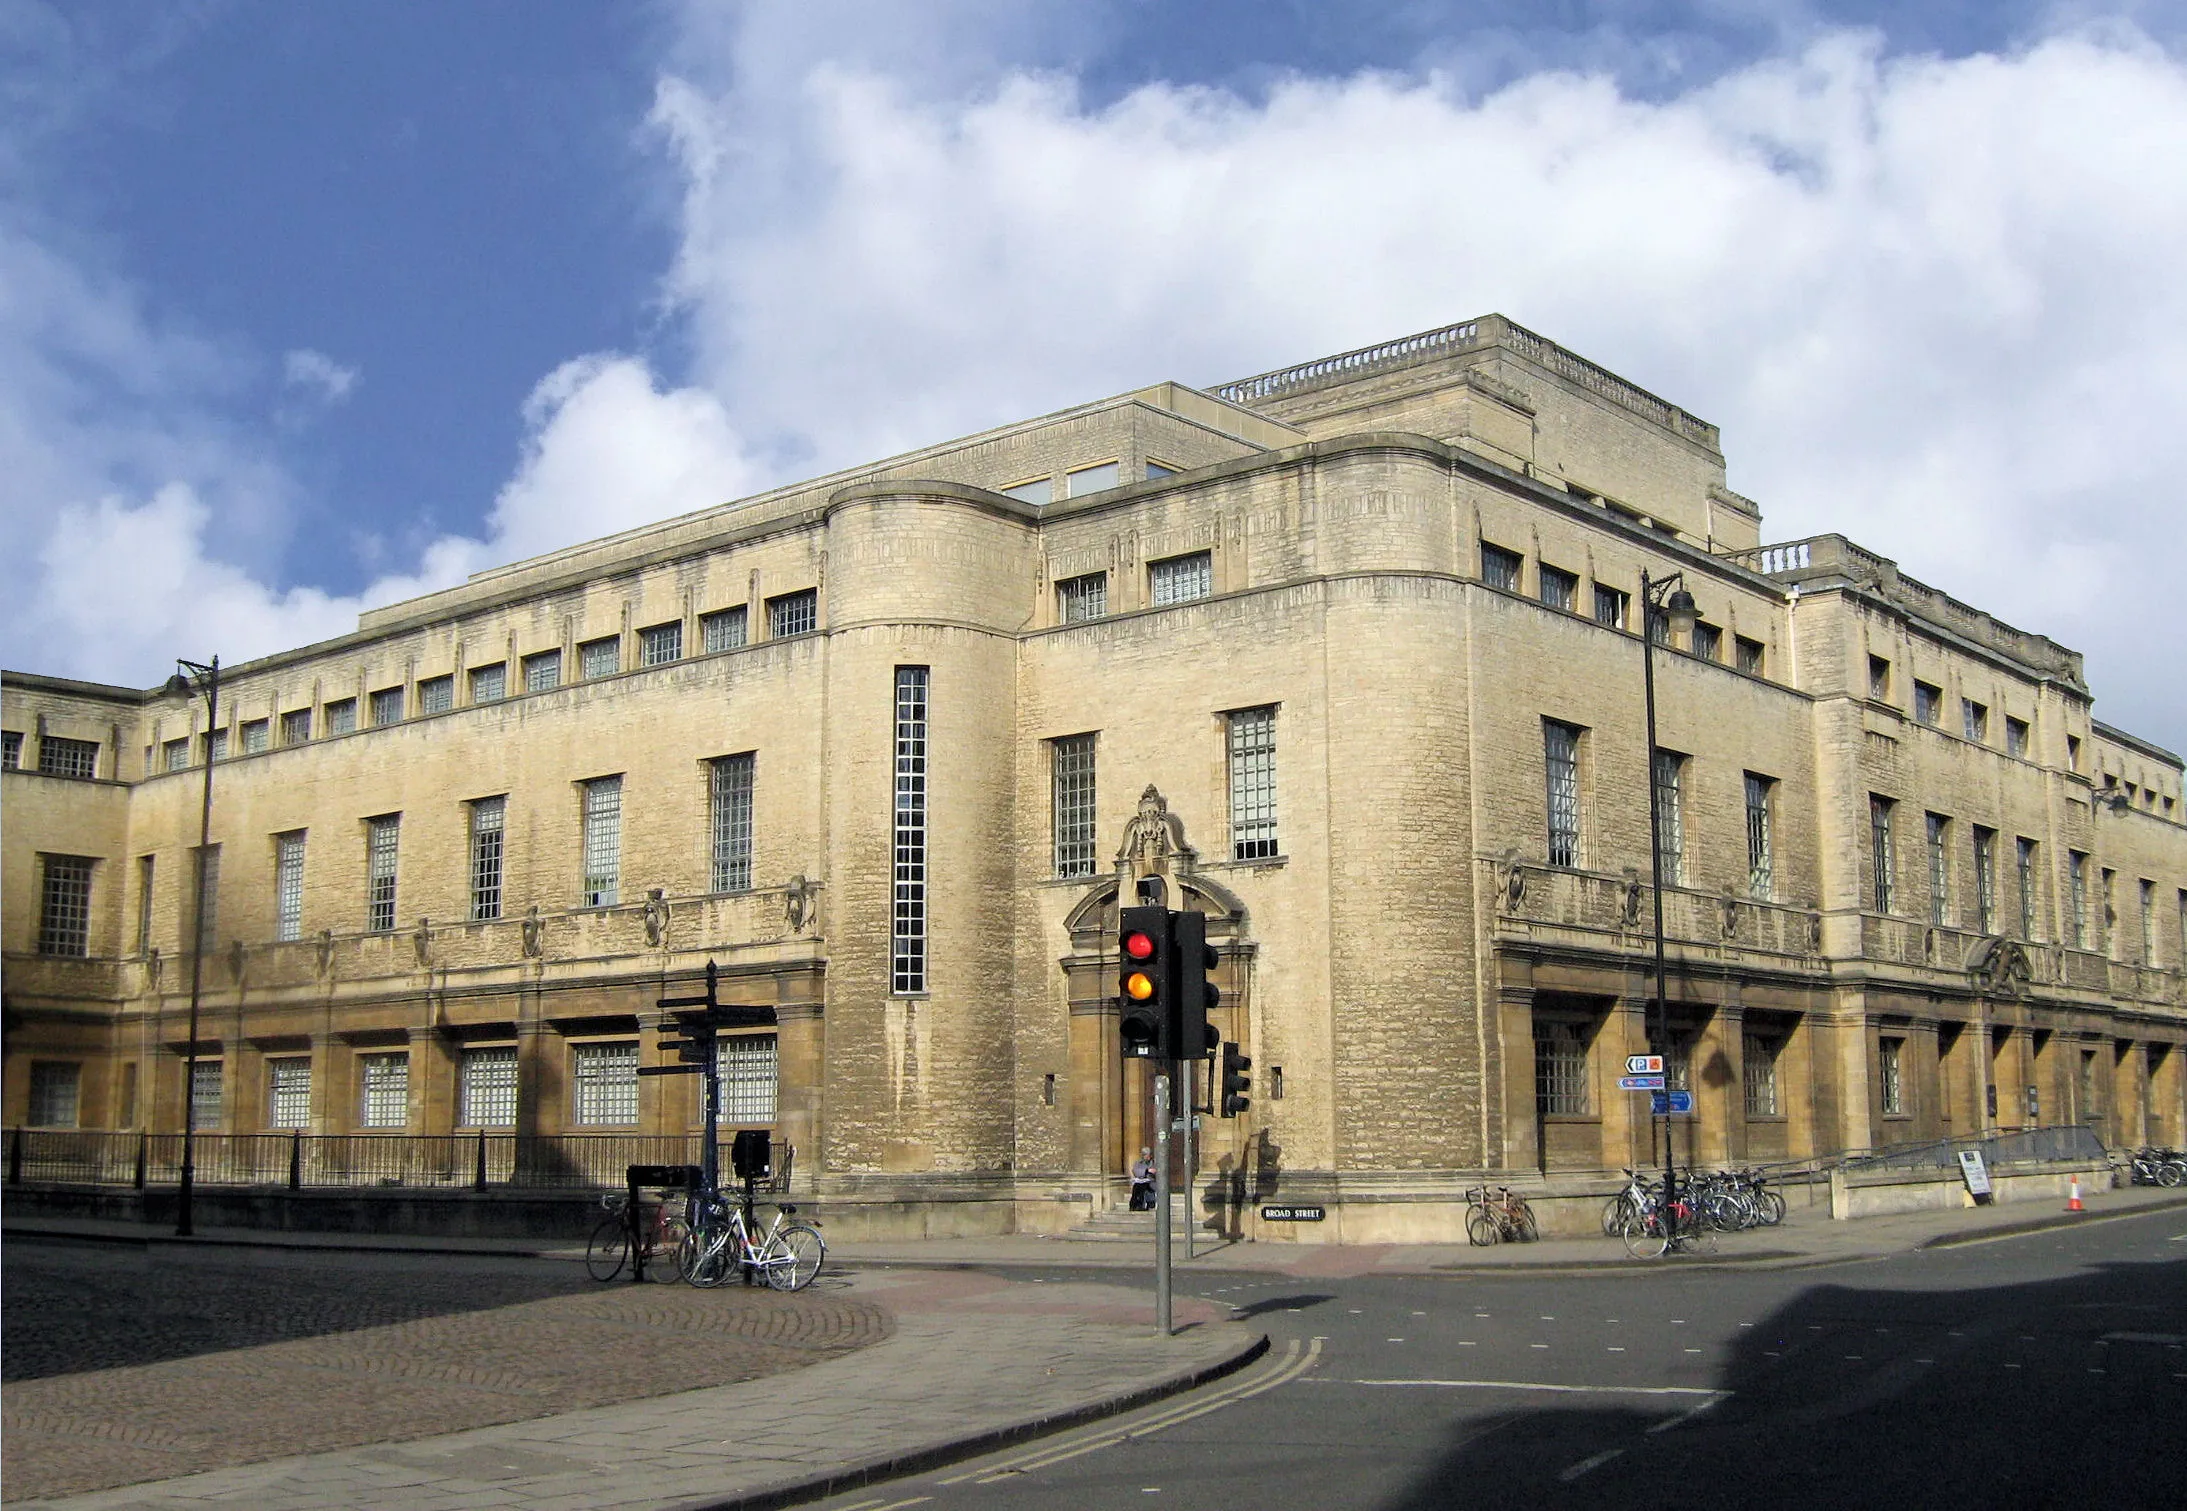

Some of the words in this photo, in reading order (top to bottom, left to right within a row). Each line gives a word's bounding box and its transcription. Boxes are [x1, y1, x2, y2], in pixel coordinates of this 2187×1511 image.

[1637, 1059, 1645, 1070] P
[1265, 1209, 1291, 1218] BROAD
[1294, 1209, 1320, 1218] STREET
